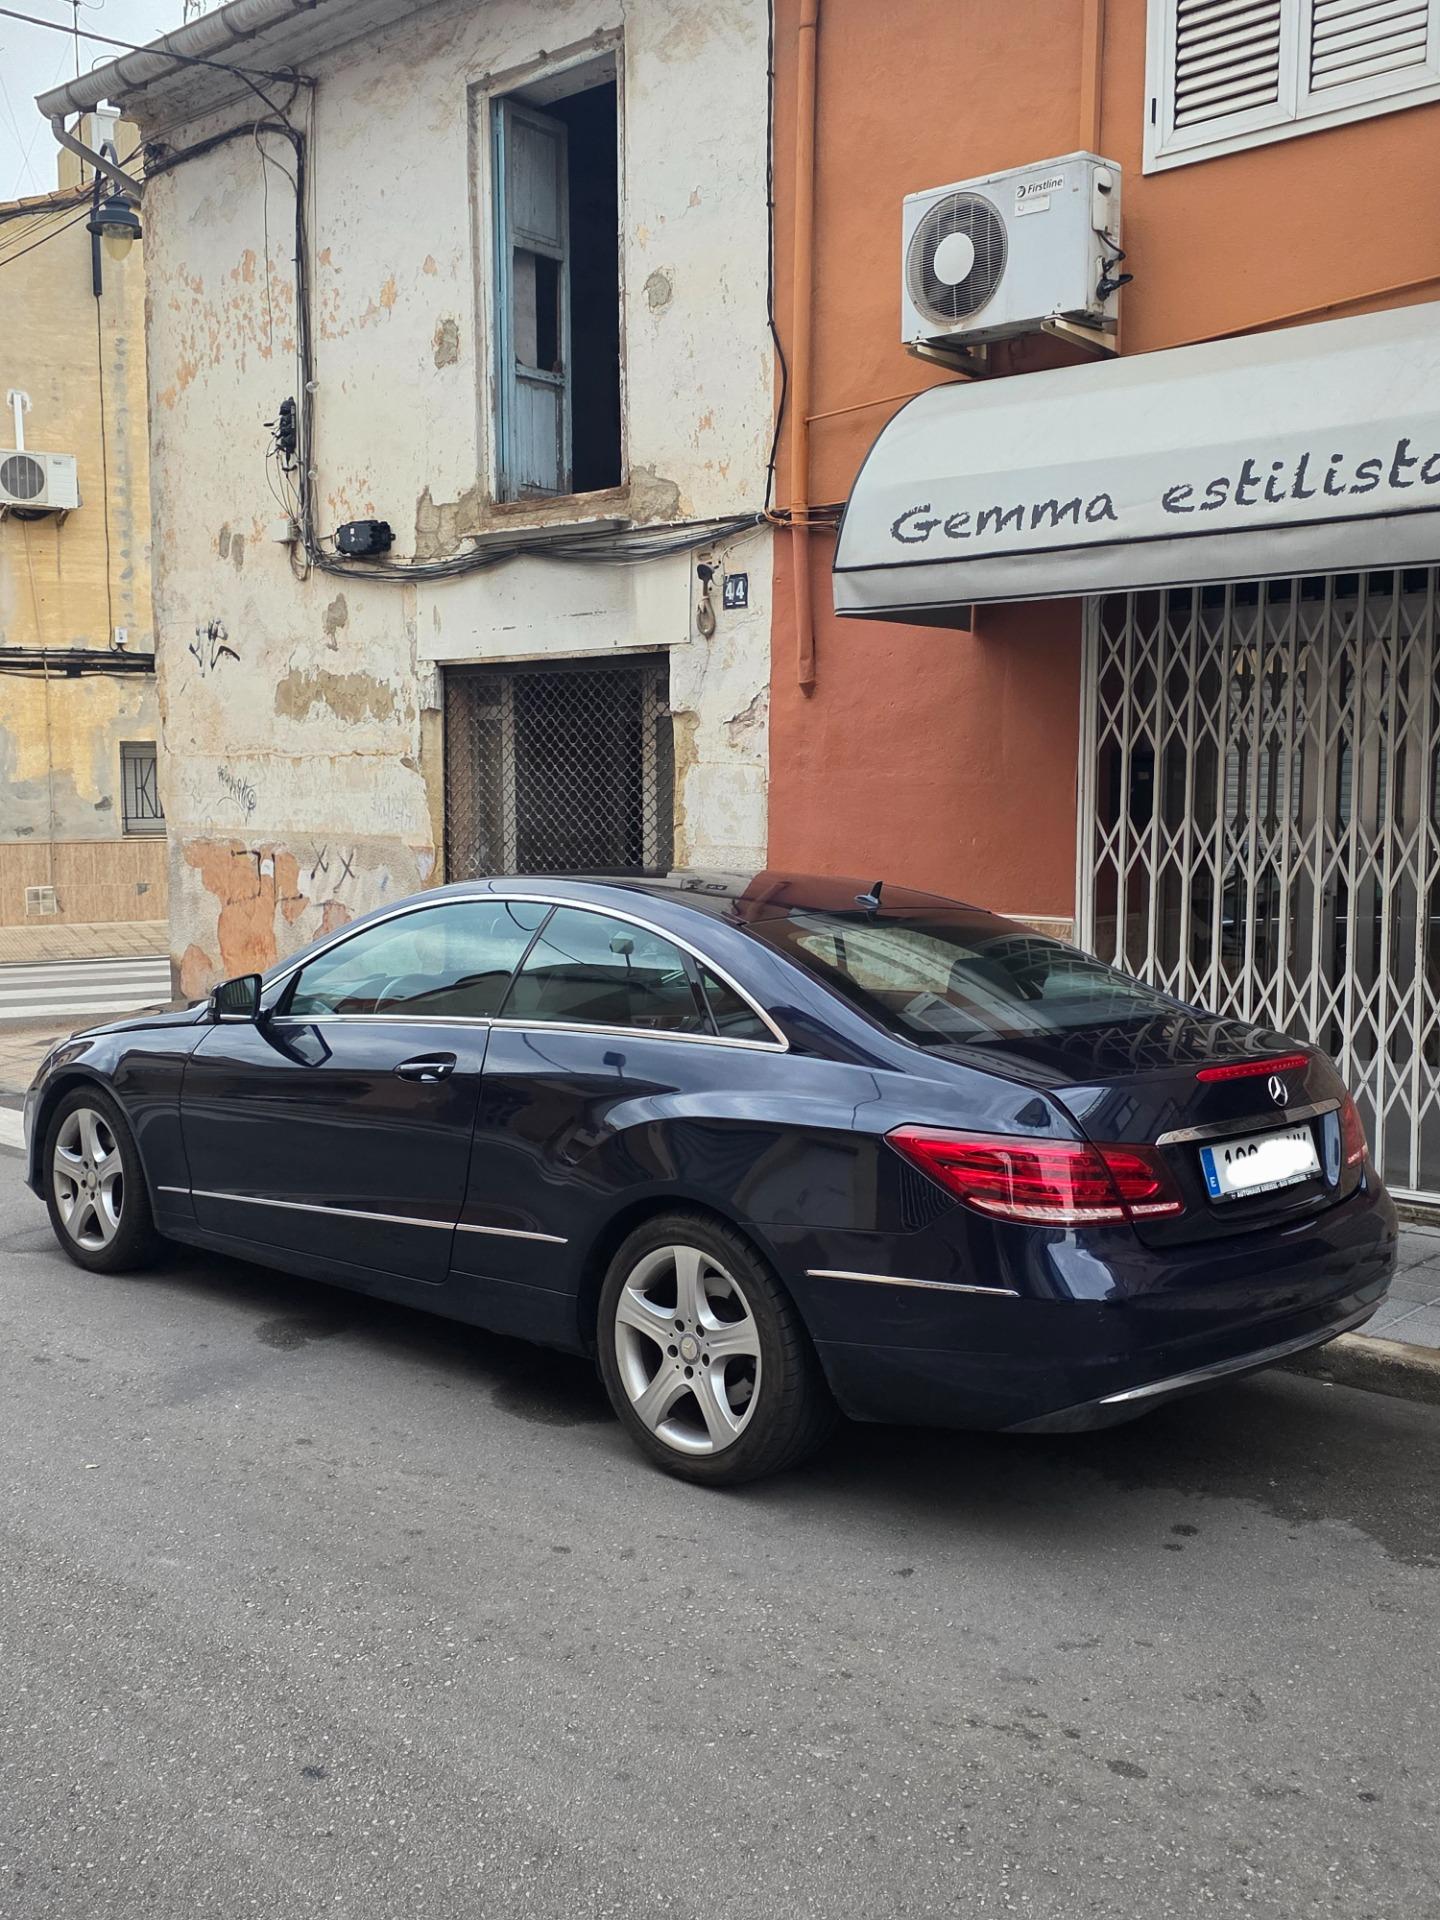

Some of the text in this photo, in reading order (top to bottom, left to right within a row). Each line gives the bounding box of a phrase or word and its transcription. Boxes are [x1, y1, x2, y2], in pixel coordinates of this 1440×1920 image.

[1027, 178, 1063, 194] Firstline
[890, 492, 1118, 544] Gemma
[725, 580, 745, 600] 44
[1209, 1176, 1217, 1187] E
